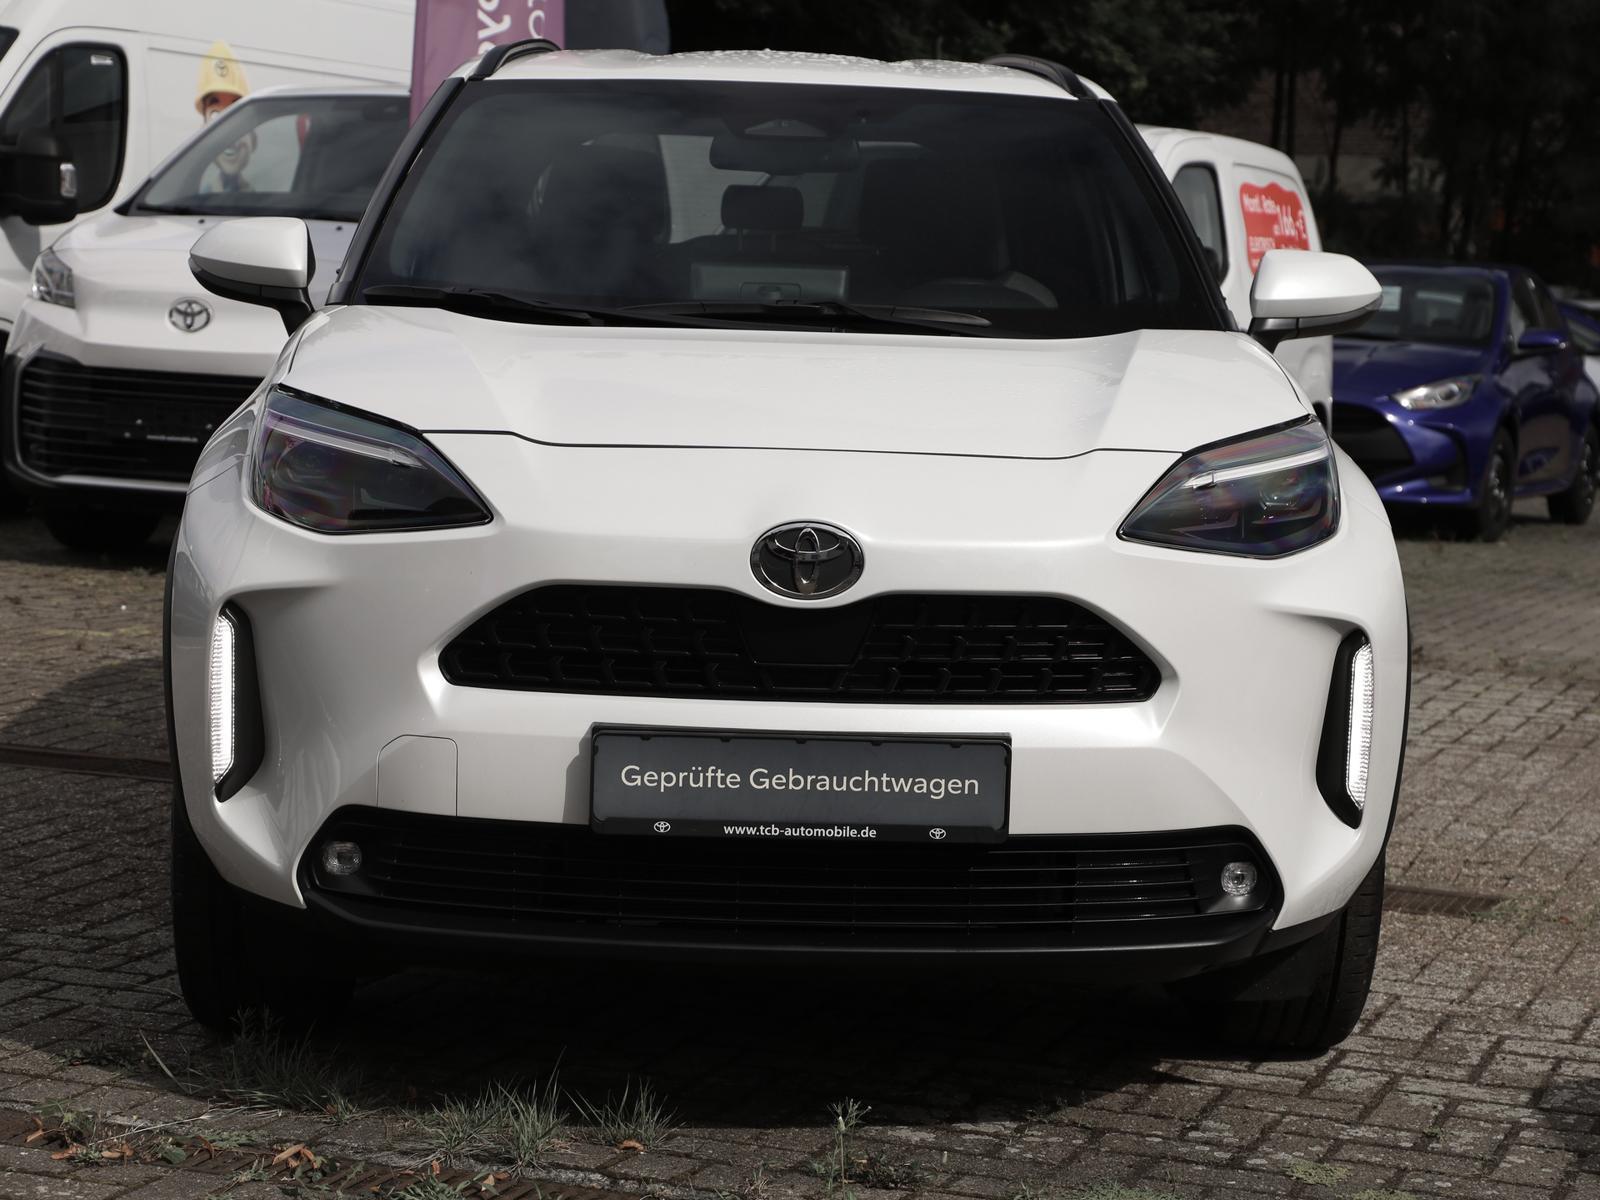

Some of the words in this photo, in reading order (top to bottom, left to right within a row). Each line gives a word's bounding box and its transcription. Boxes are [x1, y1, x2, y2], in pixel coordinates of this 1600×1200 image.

[620, 764, 741, 792] Geprüfte
[749, 768, 979, 799] Gebrauchtwagen
[723, 824, 877, 839] www.tcb-automobile.de
